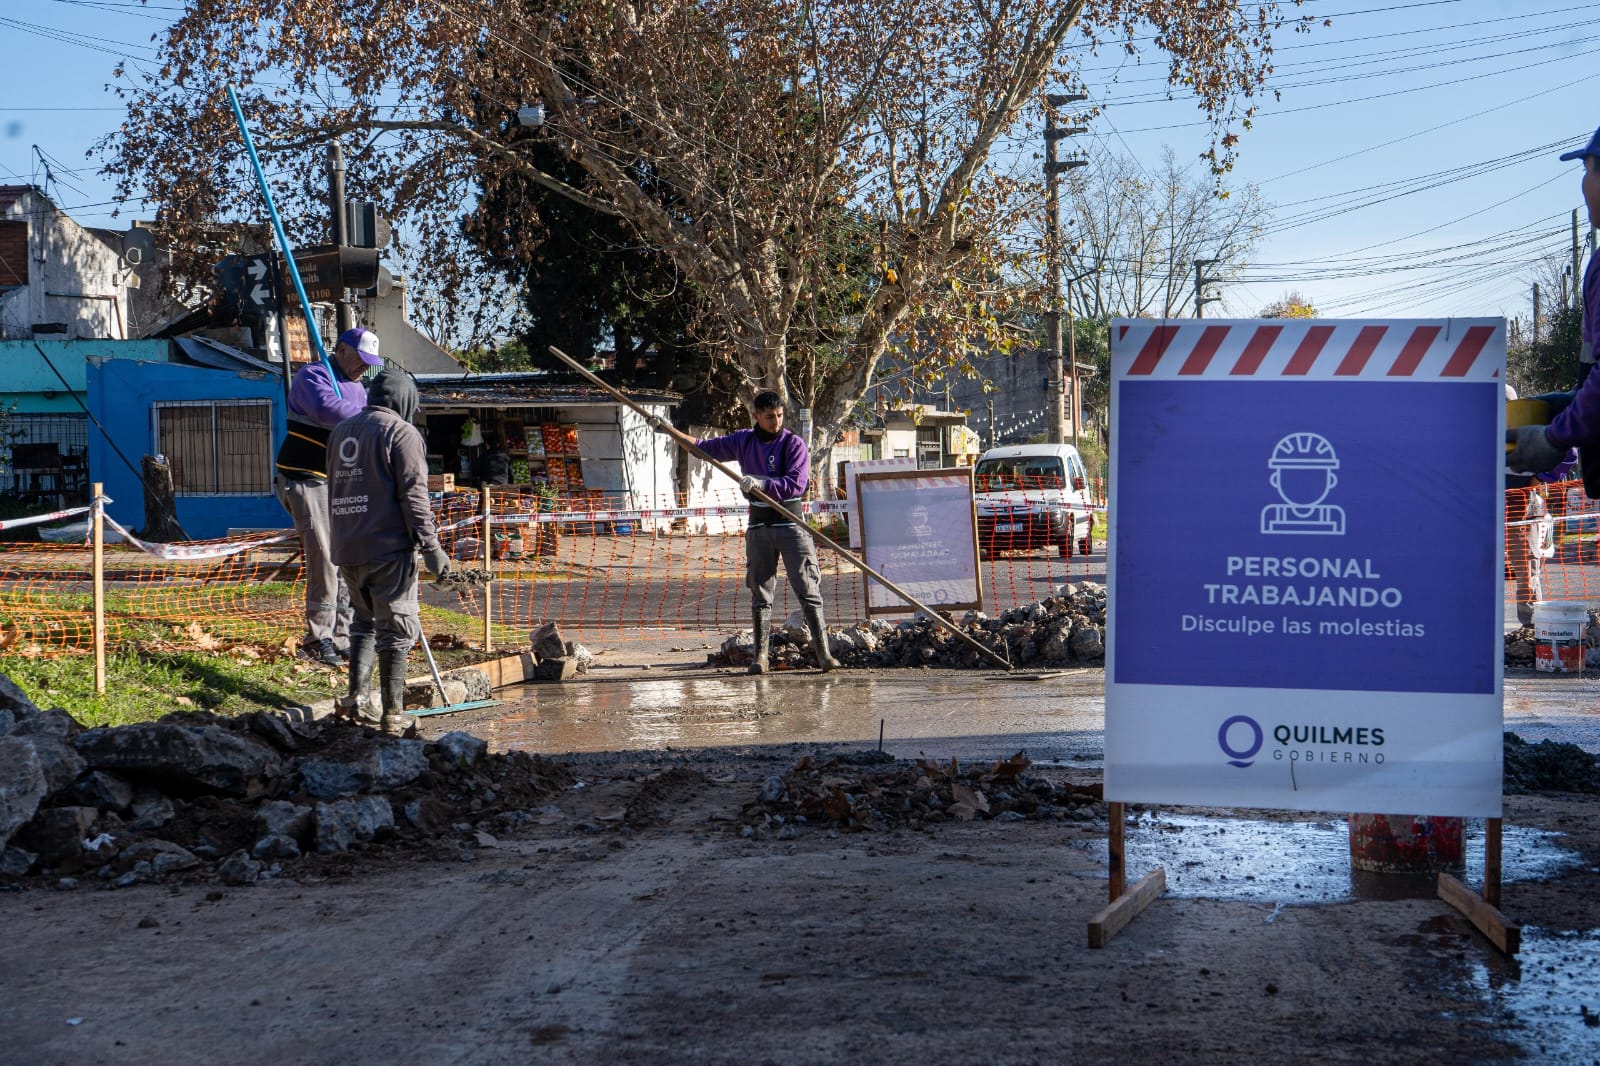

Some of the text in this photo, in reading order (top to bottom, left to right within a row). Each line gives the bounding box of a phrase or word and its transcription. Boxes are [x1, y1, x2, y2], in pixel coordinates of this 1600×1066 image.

[286, 288, 331, 302] 10-1100
[1227, 556, 1381, 579] PERSONAL
[1203, 583, 1403, 608] TRABAJANDO
[1181, 614, 1425, 637] Disculpe las molestias
[1273, 724, 1386, 746] QUILMES
[1273, 749, 1386, 765] GOBIERNO
